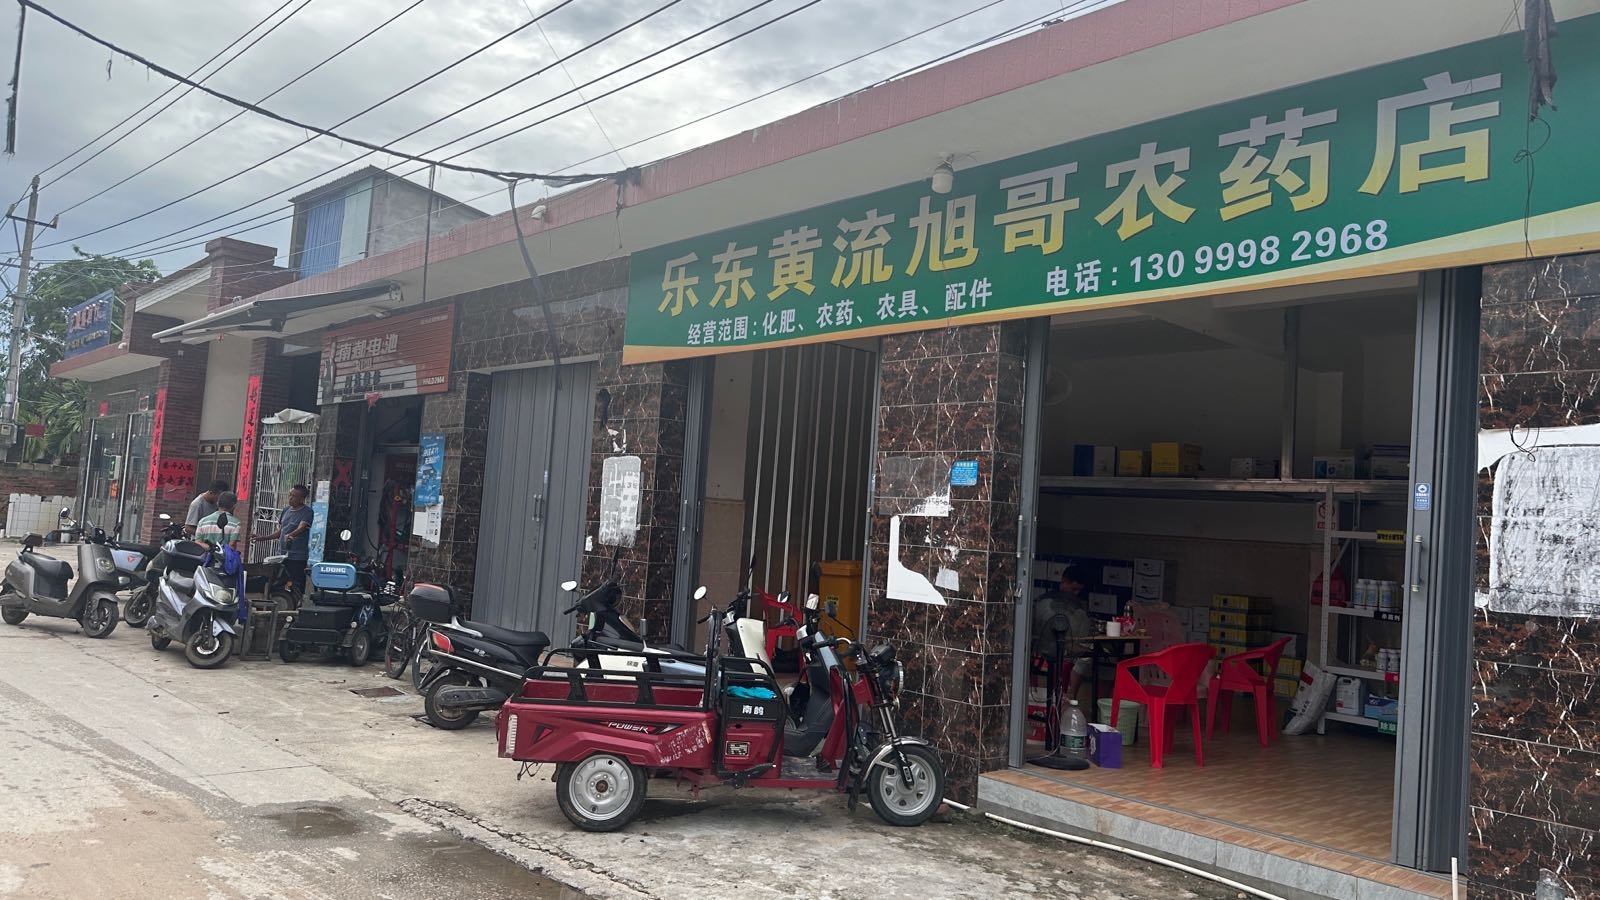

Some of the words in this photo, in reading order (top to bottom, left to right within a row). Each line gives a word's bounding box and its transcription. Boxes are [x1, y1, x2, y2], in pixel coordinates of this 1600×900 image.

[657, 70, 1502, 318] 乐东黄流旭哥农药店
[1194, 235, 1280, 275] 9998
[1290, 219, 1389, 262] 2968
[607, 721, 649, 734] POWER
